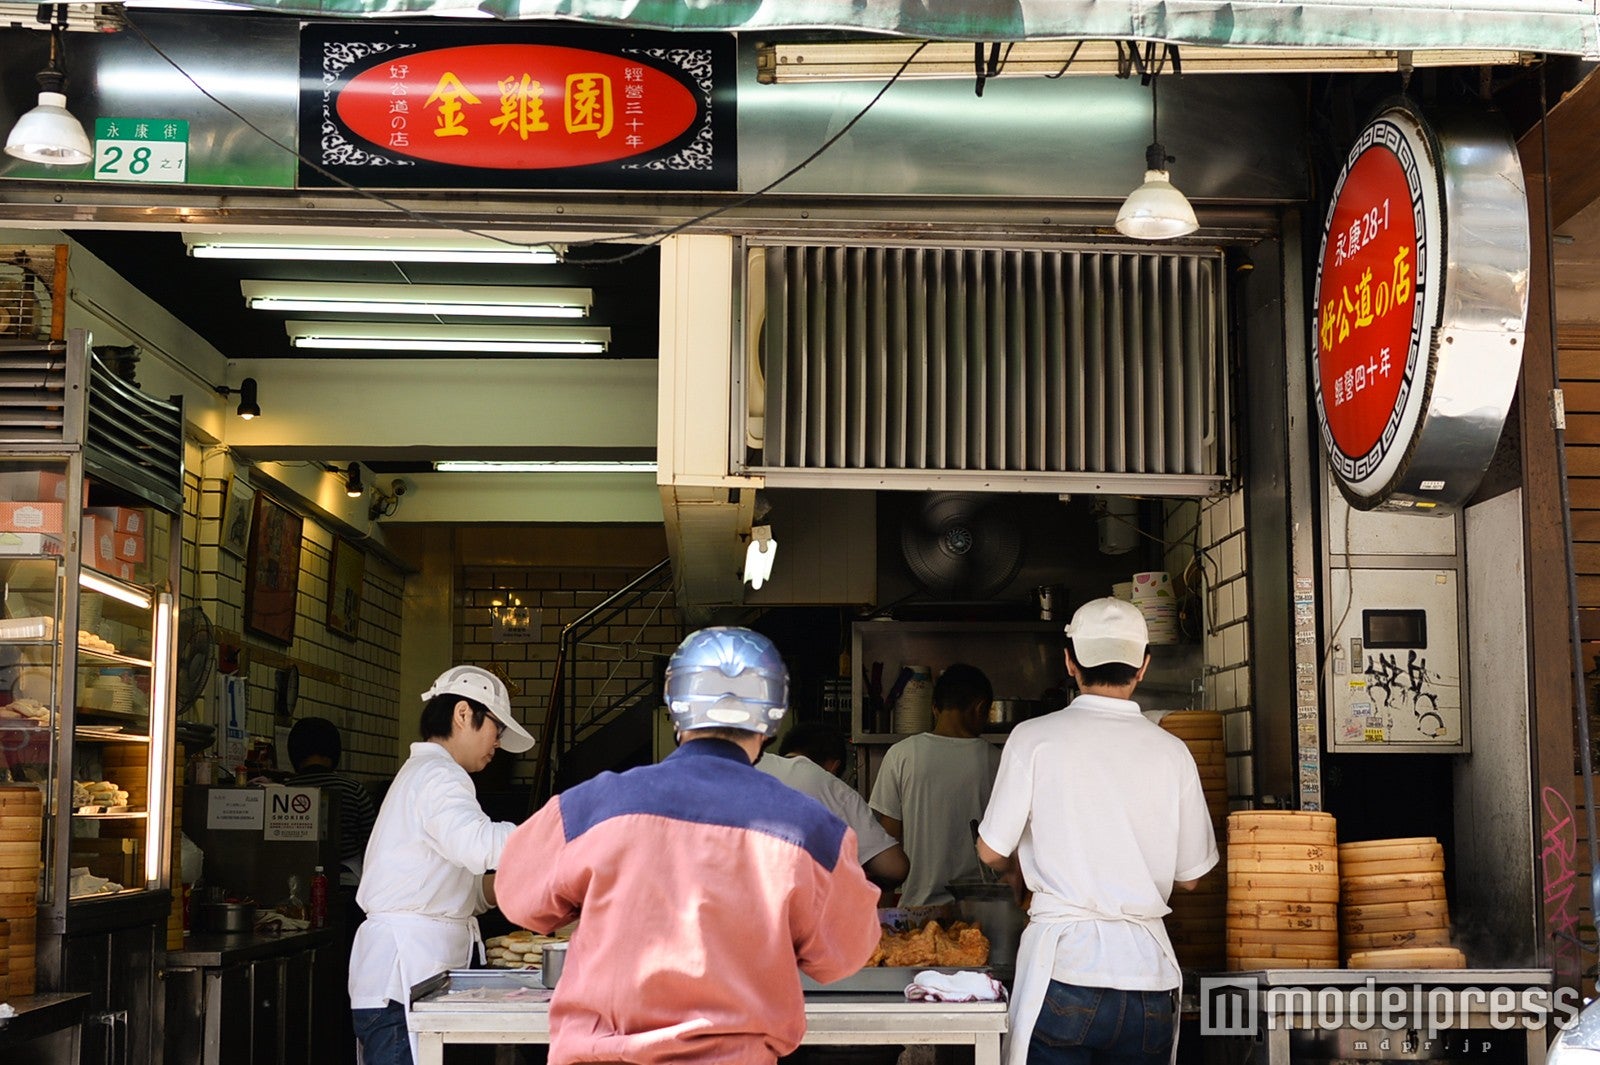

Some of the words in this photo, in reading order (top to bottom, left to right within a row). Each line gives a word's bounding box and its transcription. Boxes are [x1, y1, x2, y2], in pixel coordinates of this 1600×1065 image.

[107, 122, 177, 139] 永康街
[388, 64, 409, 147] 好公道の店
[423, 71, 614, 141] 金雞園
[624, 67, 644, 148] 經營三十年
[98, 146, 152, 175] 28
[1321, 245, 1410, 352] 好公道の店
